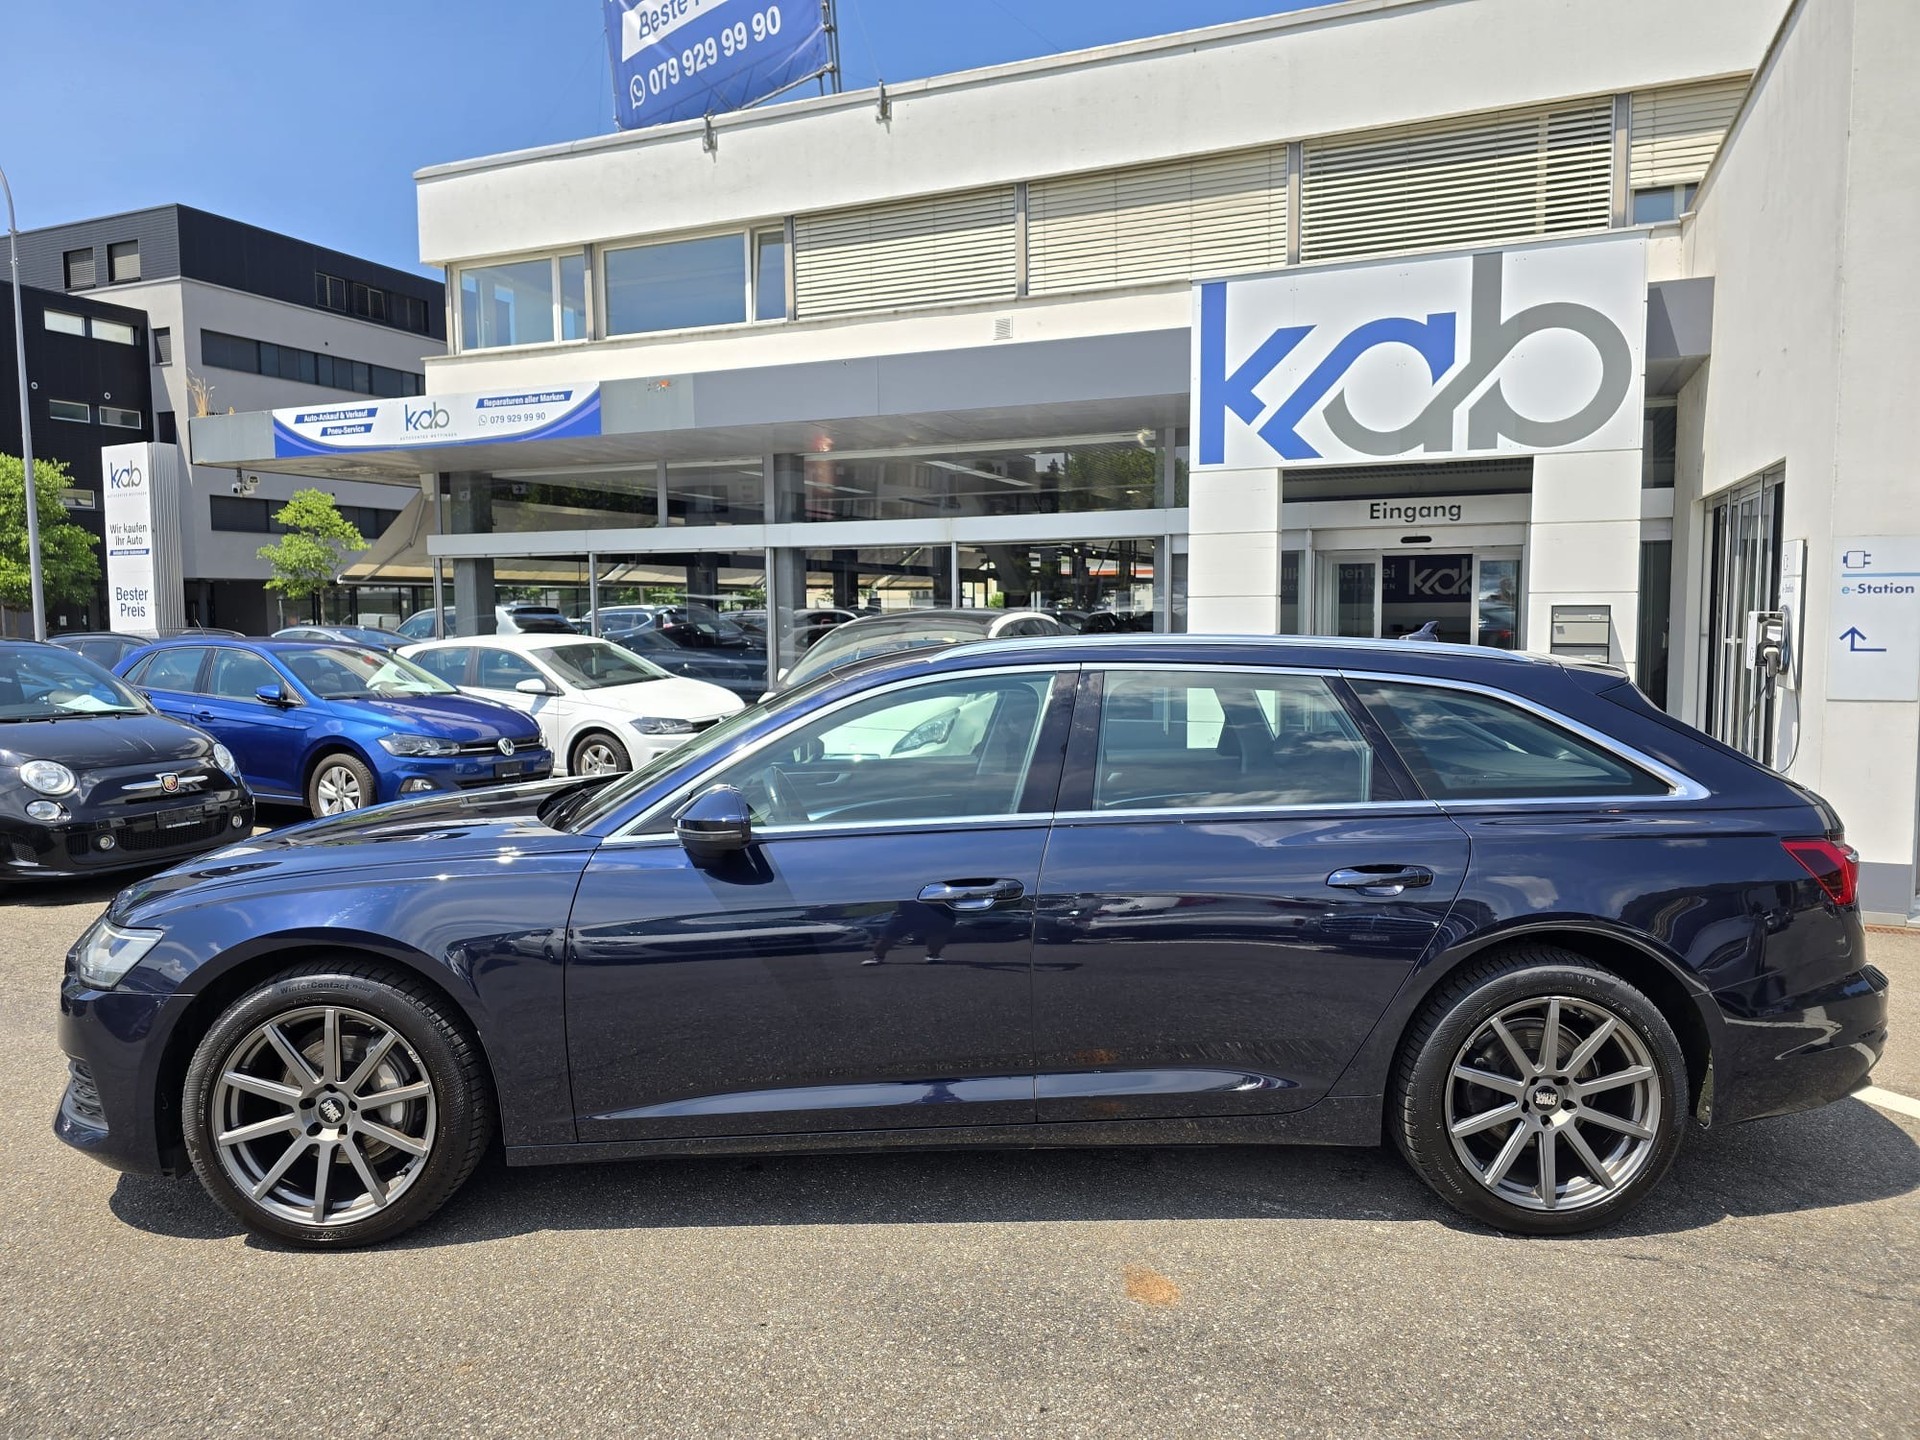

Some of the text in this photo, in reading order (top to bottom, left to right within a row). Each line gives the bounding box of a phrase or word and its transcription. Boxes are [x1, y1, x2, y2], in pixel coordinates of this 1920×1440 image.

[649, 5, 781, 95] 079 929 99 90
[303, 412, 339, 422] Auto-Ankauf
[346, 409, 368, 418] Verkauf
[405, 401, 450, 431] kab
[490, 412, 546, 424] 079 929 99 90
[110, 460, 142, 489] kab
[1369, 502, 1462, 523] Eingang
[109, 522, 148, 534] Wir kaufen
[115, 534, 143, 546] Ihr Auto
[116, 587, 149, 600] Bester
[1841, 582, 1915, 595] e-Station
[120, 602, 146, 617] Preis
[280, 981, 349, 994] WinterContact
